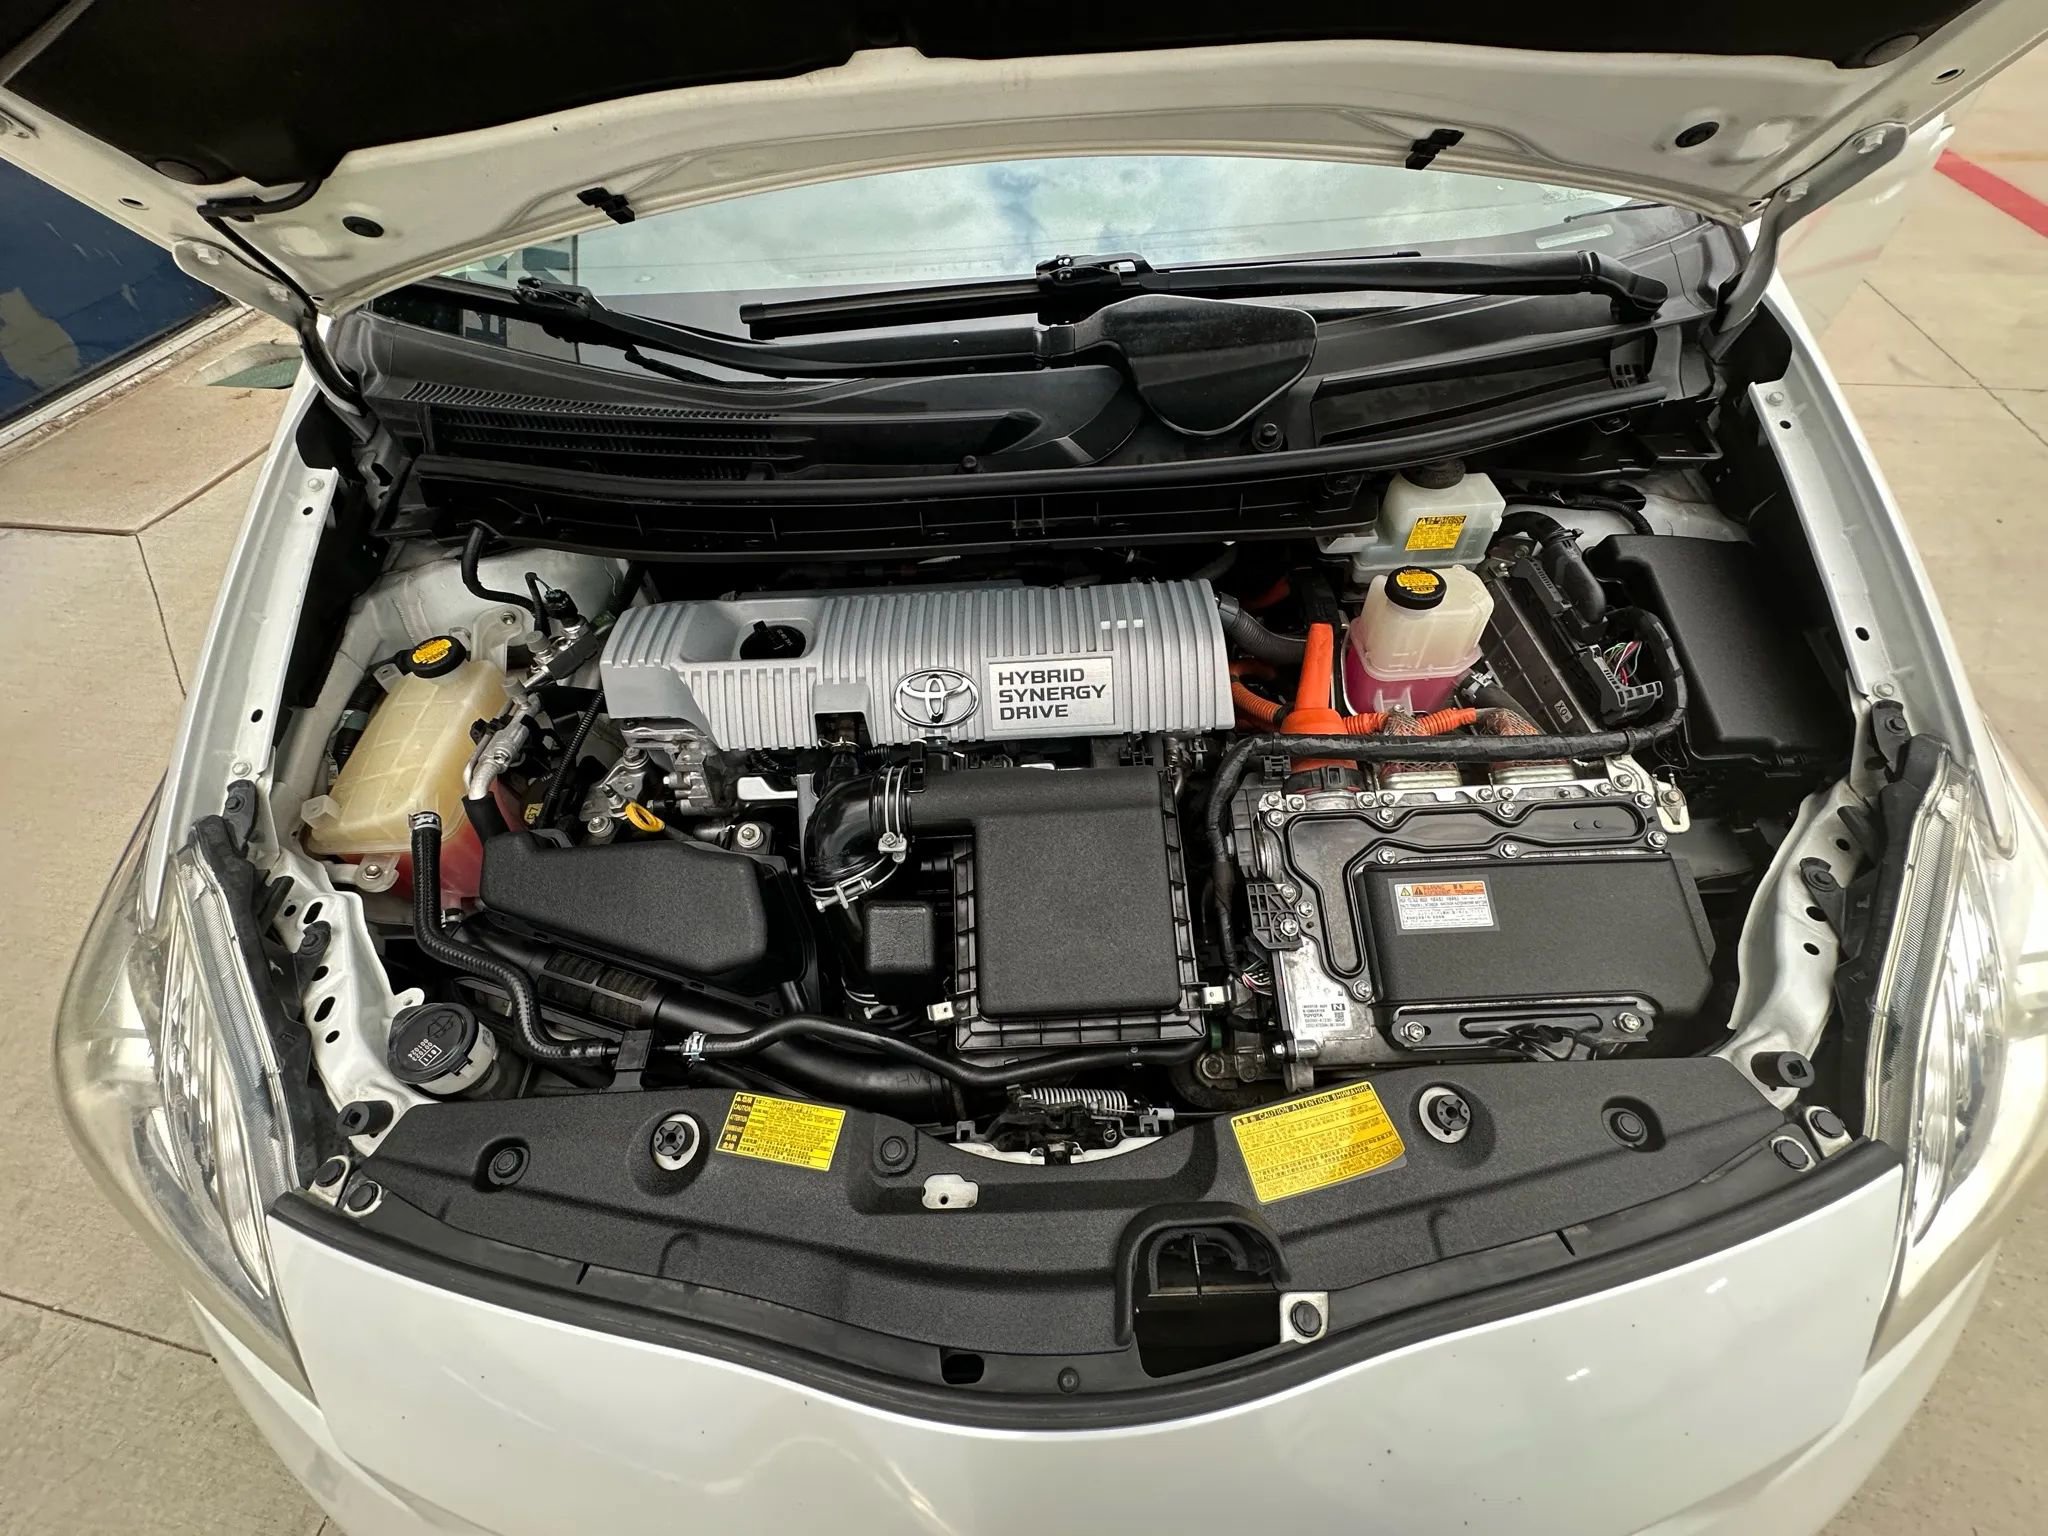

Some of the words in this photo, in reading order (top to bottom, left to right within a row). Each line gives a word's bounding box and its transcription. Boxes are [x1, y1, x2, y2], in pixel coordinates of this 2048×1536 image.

[998, 668, 1085, 686] HYBRID
[999, 684, 1107, 703] SYNERGY
[1000, 704, 1069, 721] DRIVE
[1332, 1085, 1370, 1101] ВНИМАНИЕ
[733, 1103, 751, 1112] CAUTION
[1258, 1105, 1289, 1120] CAUTION
[1292, 1095, 1330, 1111] ATTENTION
